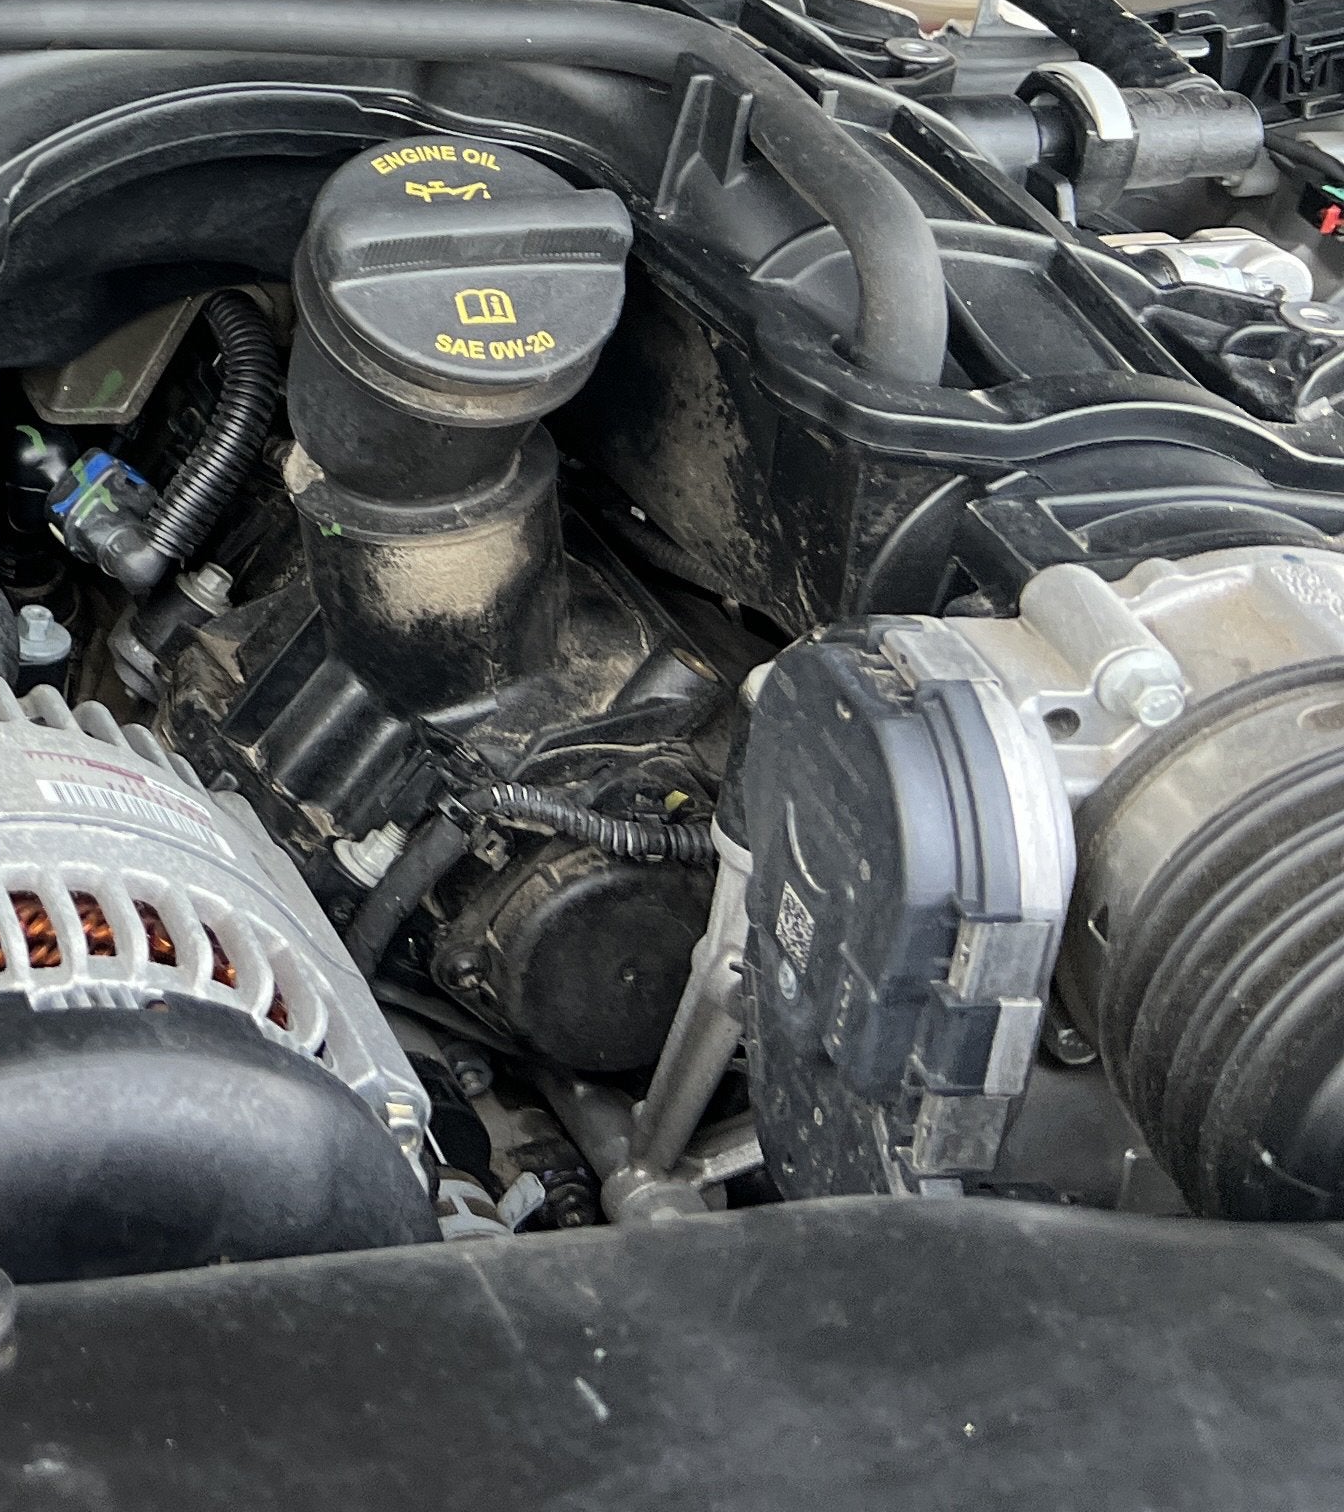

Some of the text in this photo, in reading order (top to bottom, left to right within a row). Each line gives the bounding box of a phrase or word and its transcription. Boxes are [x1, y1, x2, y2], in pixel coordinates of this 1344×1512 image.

[370, 145, 502, 176] ENGINE OIL
[434, 330, 556, 361] SAE 0W-20
